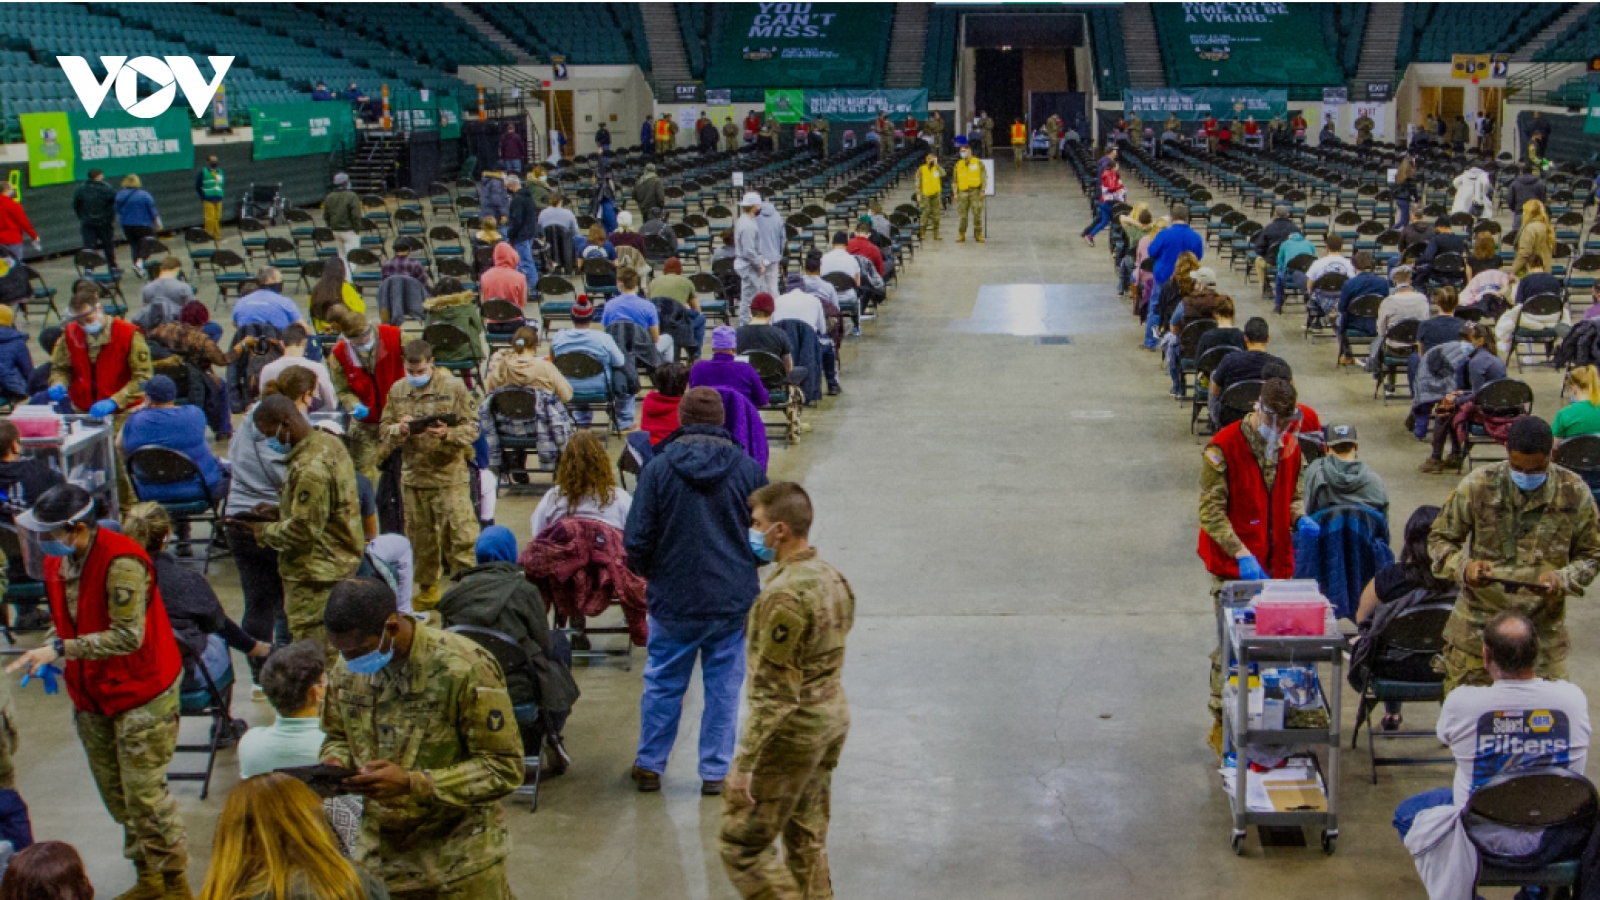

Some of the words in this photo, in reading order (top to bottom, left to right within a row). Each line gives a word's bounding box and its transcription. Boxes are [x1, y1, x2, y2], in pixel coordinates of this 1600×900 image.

[758, 2, 812, 14] YOU
[753, 13, 837, 26] CAN'T
[1184, 14, 1197, 22] A
[748, 25, 827, 37] MISS.
[676, 86, 697, 94] EXIT
[1368, 83, 1390, 92] EXIT
[1479, 734, 1567, 754] Filters
